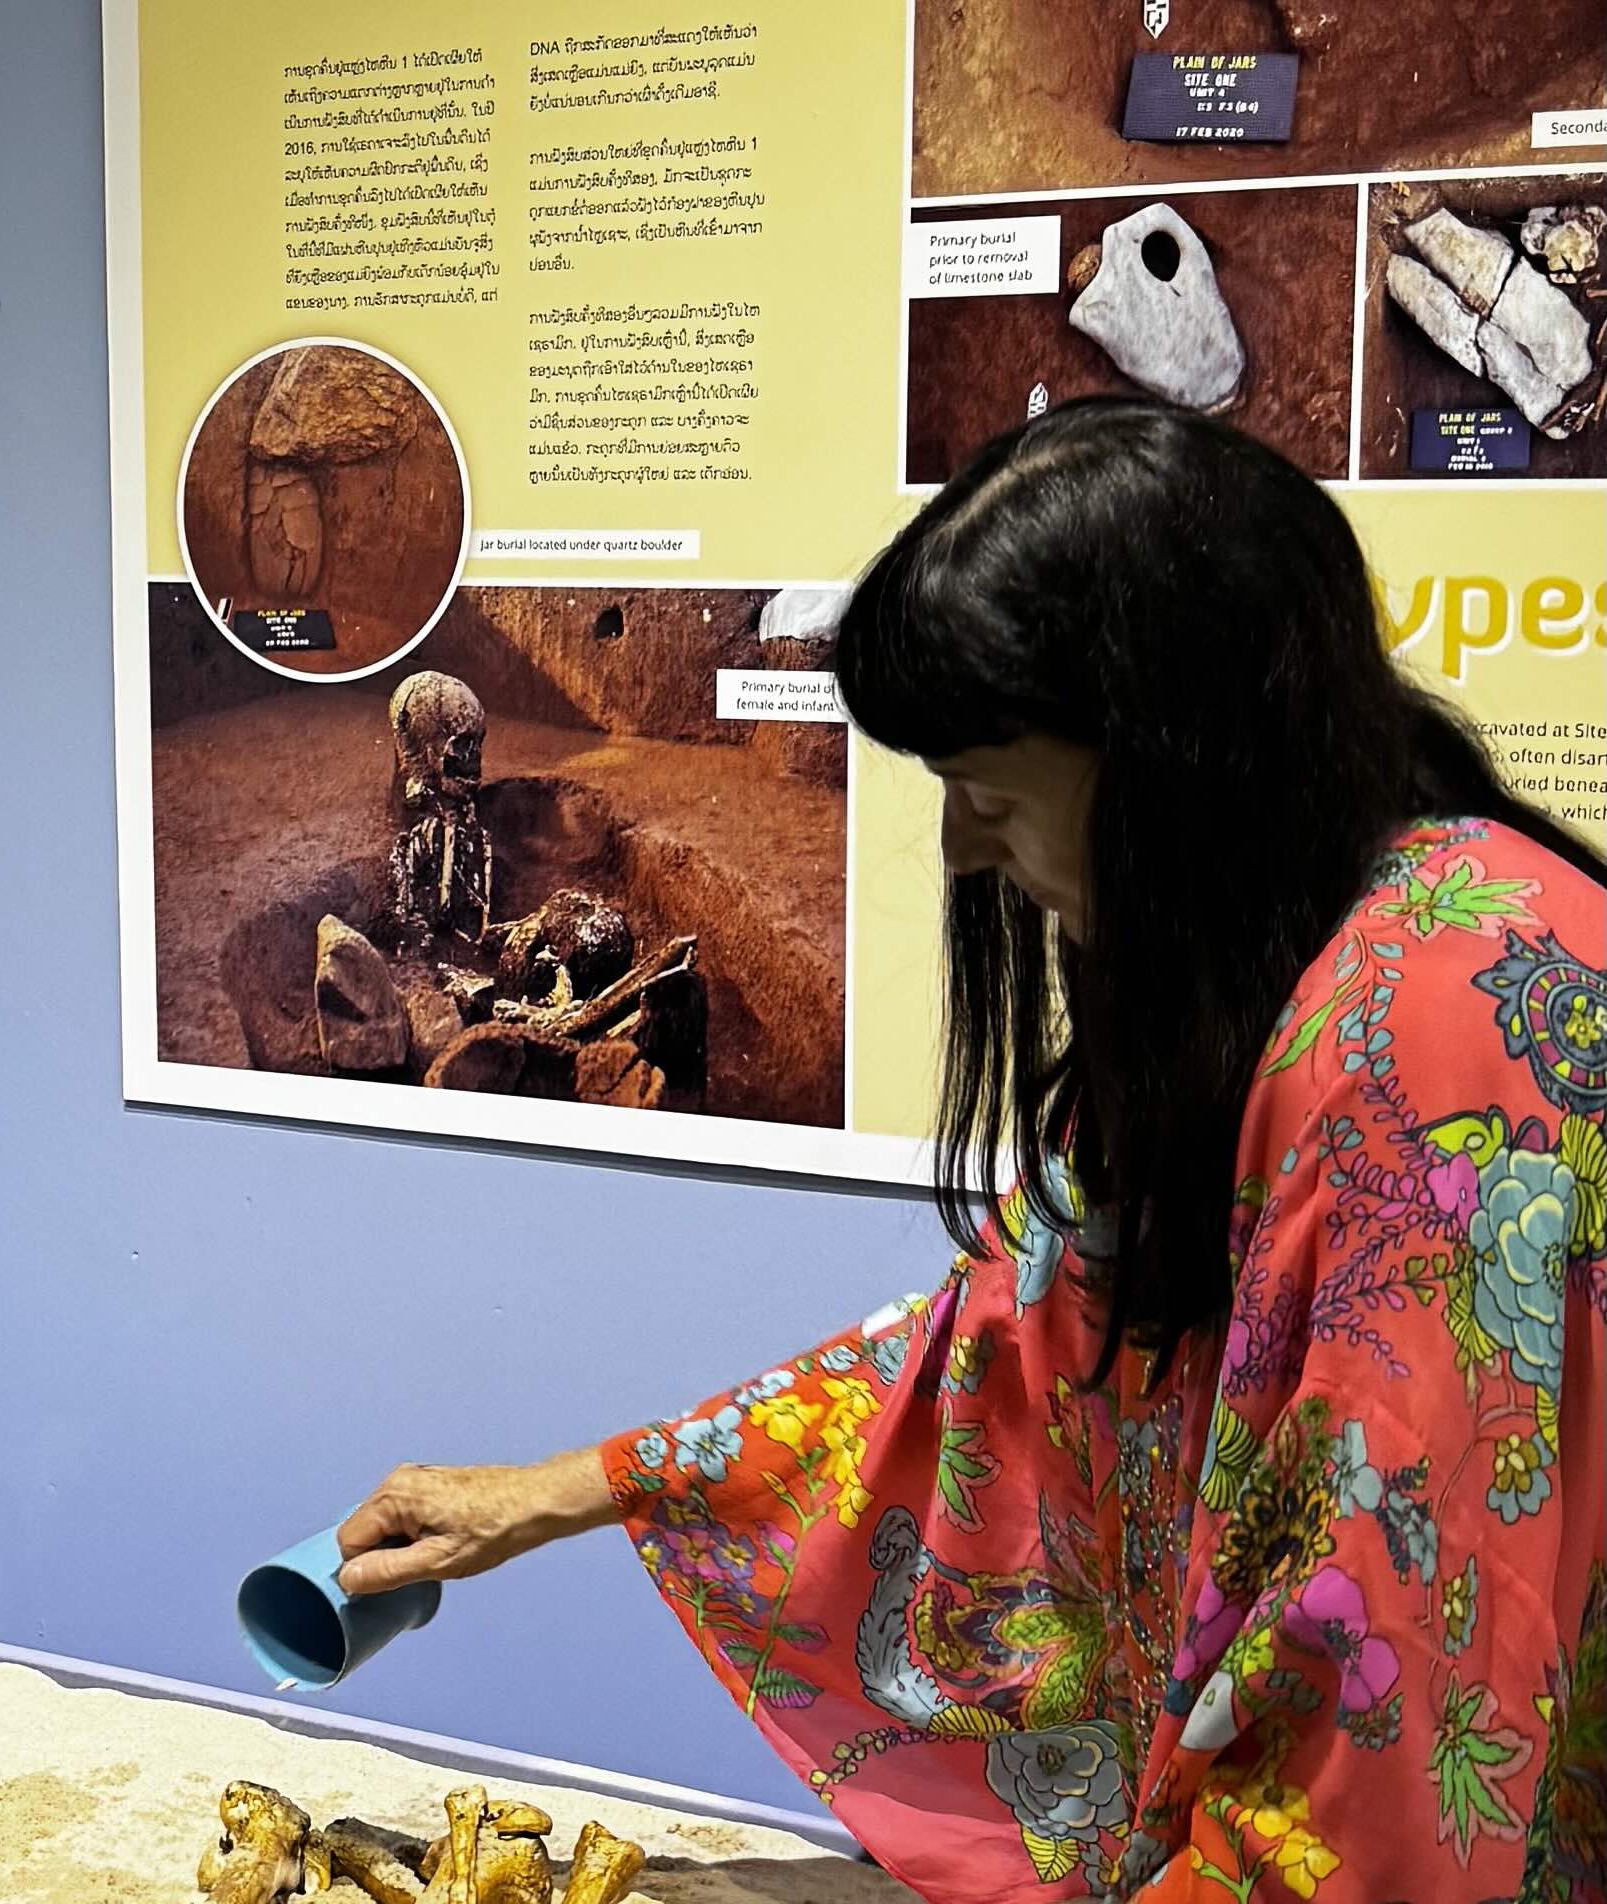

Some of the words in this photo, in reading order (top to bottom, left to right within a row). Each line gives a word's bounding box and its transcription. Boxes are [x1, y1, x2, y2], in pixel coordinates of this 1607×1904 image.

[530, 41, 560, 56] DNA
[402, 55, 408, 69] 1
[285, 141, 317, 156] 2016,
[751, 137, 758, 151] 1
[980, 231, 1016, 246] burial
[929, 254, 959, 269] prior
[962, 253, 975, 266] to
[977, 250, 1029, 265] removal
[929, 272, 942, 285] of
[497, 538, 527, 551] burial
[529, 538, 567, 551] located
[569, 538, 601, 551] under
[603, 540, 638, 553] quartz
[640, 539, 683, 552] boulder
[1375, 575, 1607, 688] ype
[742, 680, 785, 696] Primary
[788, 681, 820, 694] burial
[736, 697, 774, 711] female
[778, 699, 798, 712] and
[801, 700, 835, 712] infant
[1553, 723, 1569, 737] at
[1509, 748, 1555, 764] often
